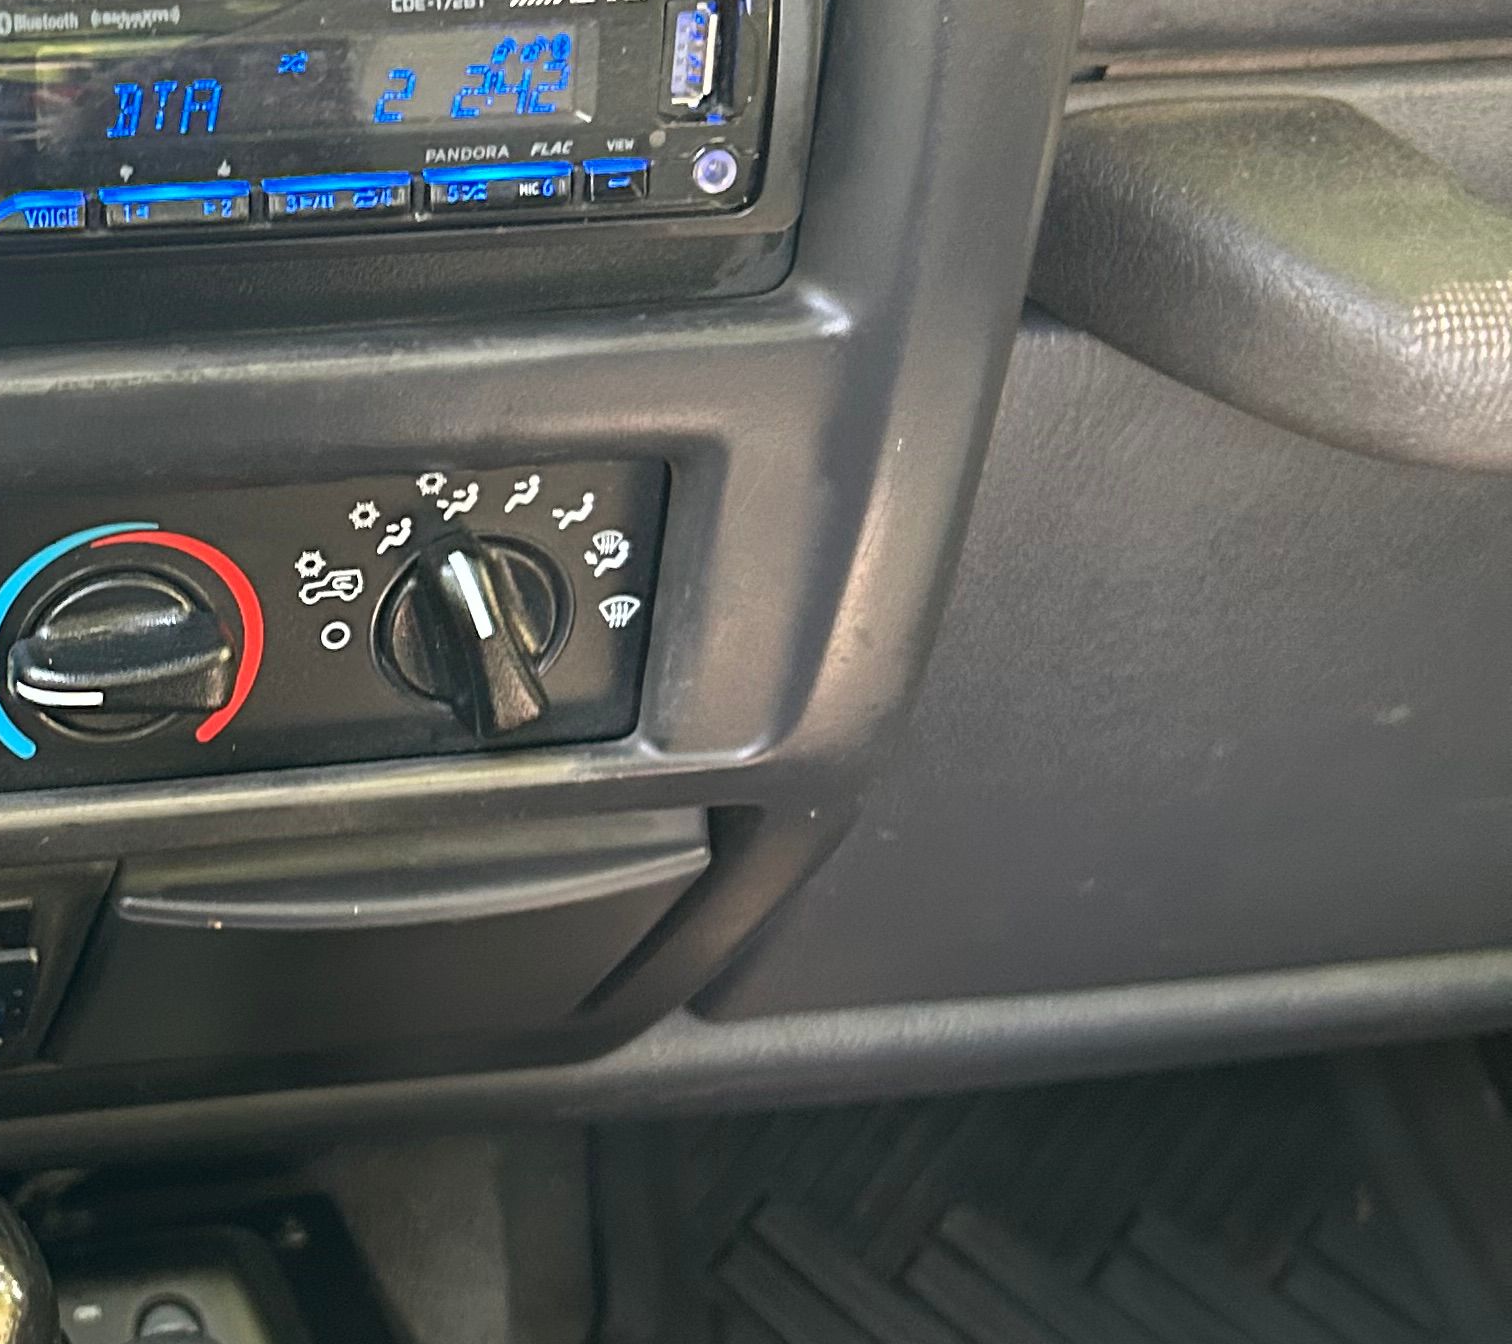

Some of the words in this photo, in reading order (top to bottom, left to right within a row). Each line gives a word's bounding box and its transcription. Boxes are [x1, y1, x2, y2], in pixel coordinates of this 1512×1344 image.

[14, 12, 79, 33] Bluetooth
[425, 144, 510, 164] PANDORA
[530, 140, 574, 157] FLAC
[606, 138, 635, 153] VIEW
[24, 206, 79, 229] VOICE
